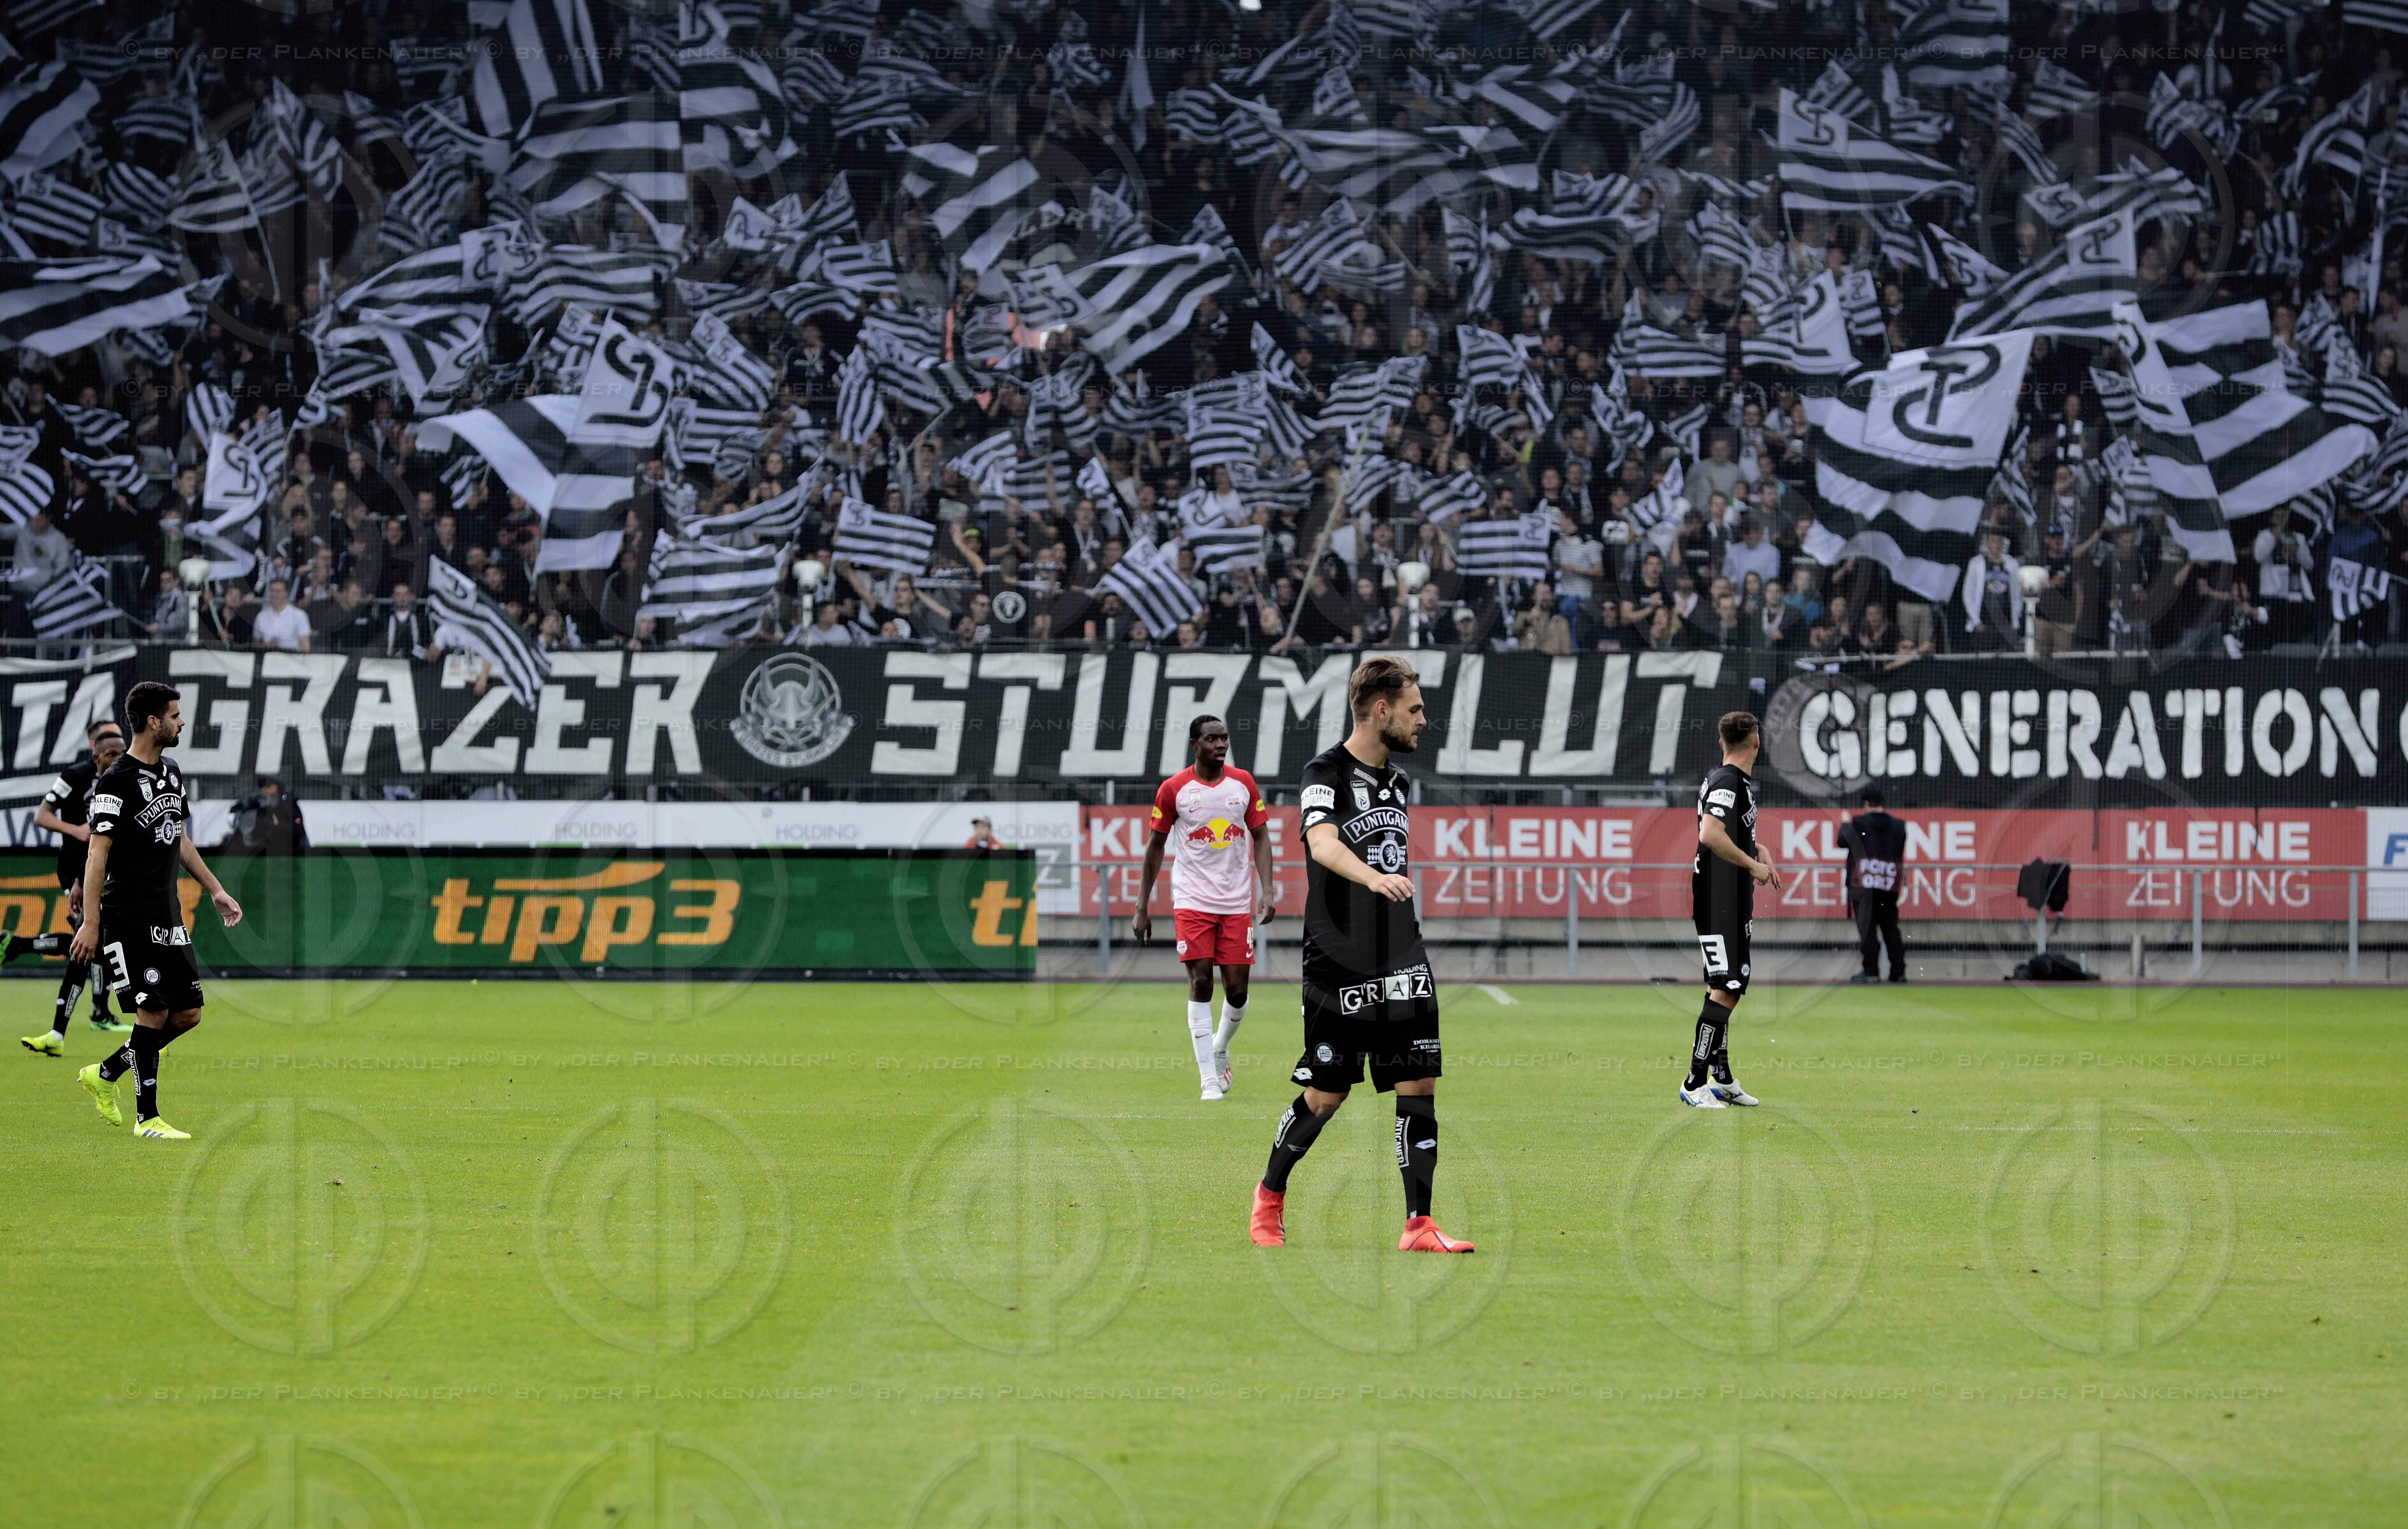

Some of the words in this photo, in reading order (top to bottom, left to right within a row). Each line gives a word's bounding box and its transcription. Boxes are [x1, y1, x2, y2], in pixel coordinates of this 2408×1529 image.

[161, 649, 717, 775] GRAZER
[871, 649, 1723, 777] STURMLUT
[1799, 687, 2379, 780] GENERATION
[333, 822, 415, 838] HOLDING
[555, 822, 637, 839] HOLDING
[776, 823, 860, 840] HOLDING
[1434, 818, 1632, 858] KLEINE
[1782, 821, 1975, 861] KLNE
[2127, 821, 2310, 861] KLEINE
[1435, 867, 1632, 905] ZEITUNG
[431, 861, 741, 962] tipp3
[1342, 974, 1429, 1012] GRAZ
